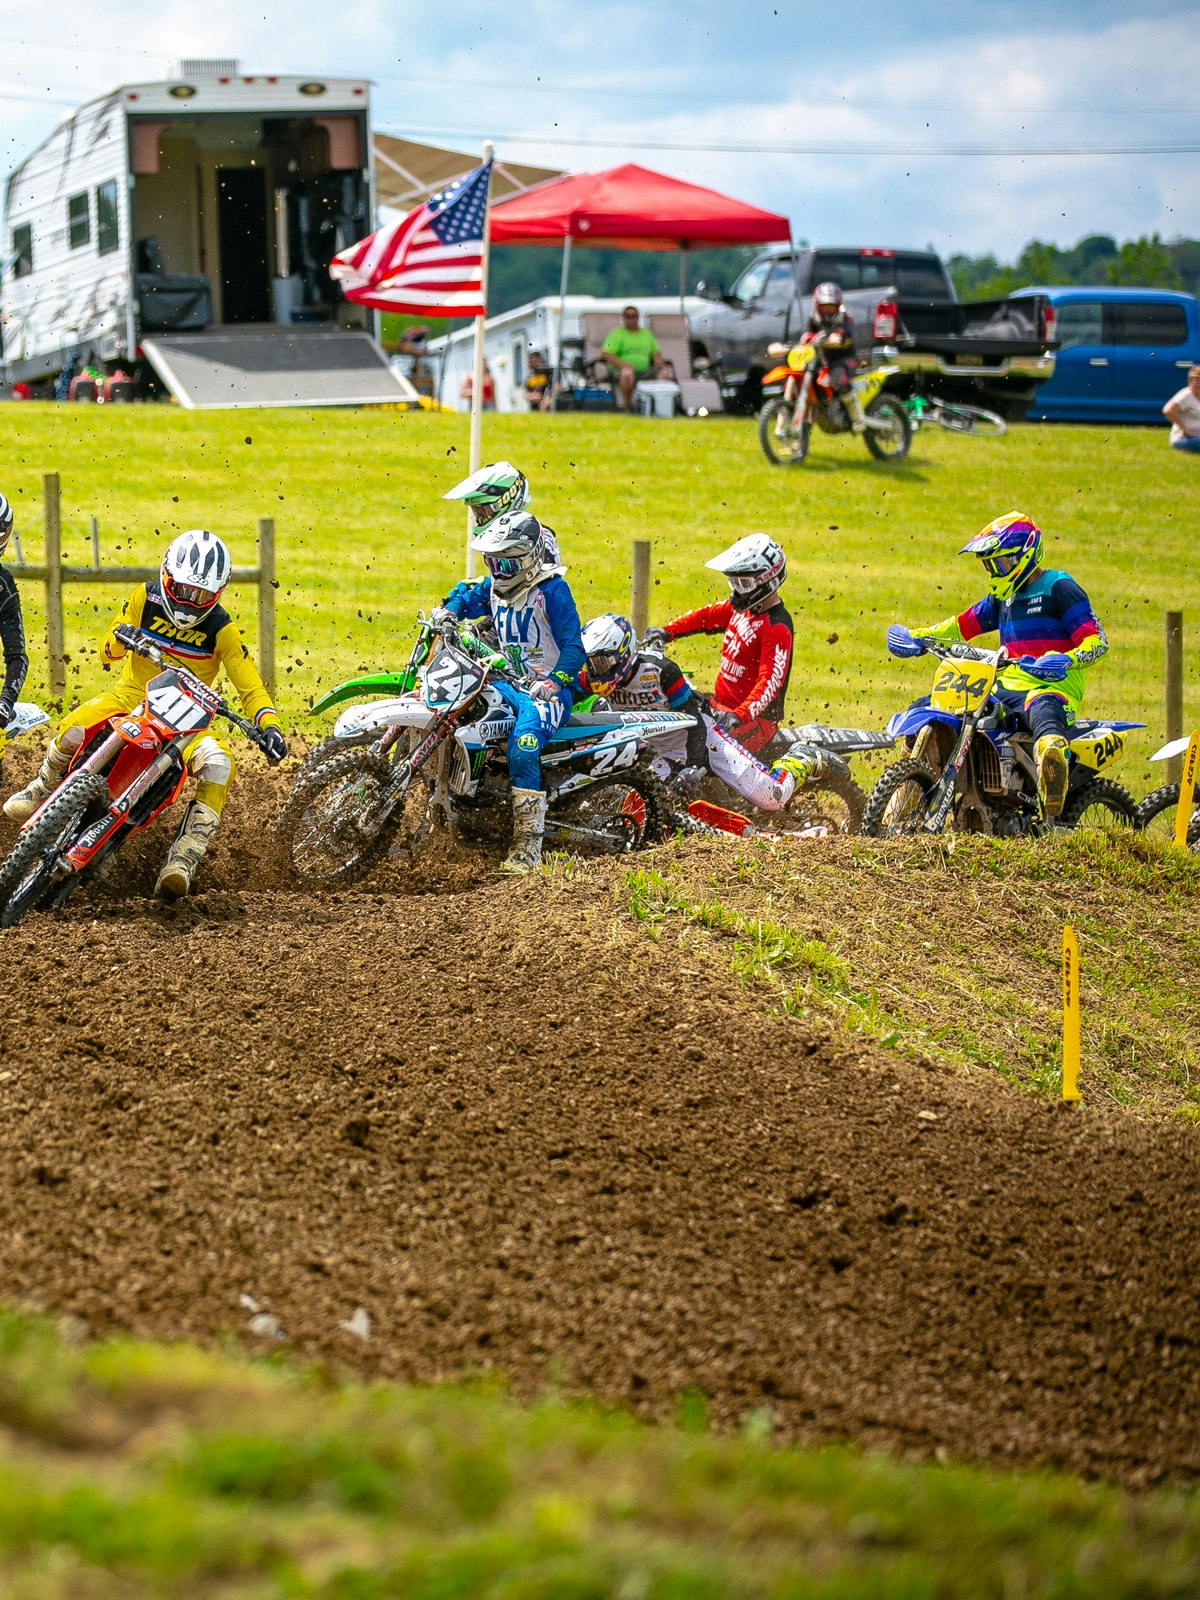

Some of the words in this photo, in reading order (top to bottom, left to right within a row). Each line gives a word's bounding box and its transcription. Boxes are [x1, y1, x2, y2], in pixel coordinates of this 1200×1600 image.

[150, 616, 208, 646] THOR
[498, 605, 535, 643] FLY
[427, 656, 479, 702] 24
[748, 643, 788, 719] FASTHOUSE
[934, 671, 989, 699] 244
[488, 720, 515, 737] YAMAH
[519, 735, 538, 748] FLY
[590, 741, 639, 777] 24
[1092, 733, 1124, 768] 244
[1186, 743, 1199, 785] ACERBIS
[935, 780, 955, 824] DUNLOP
